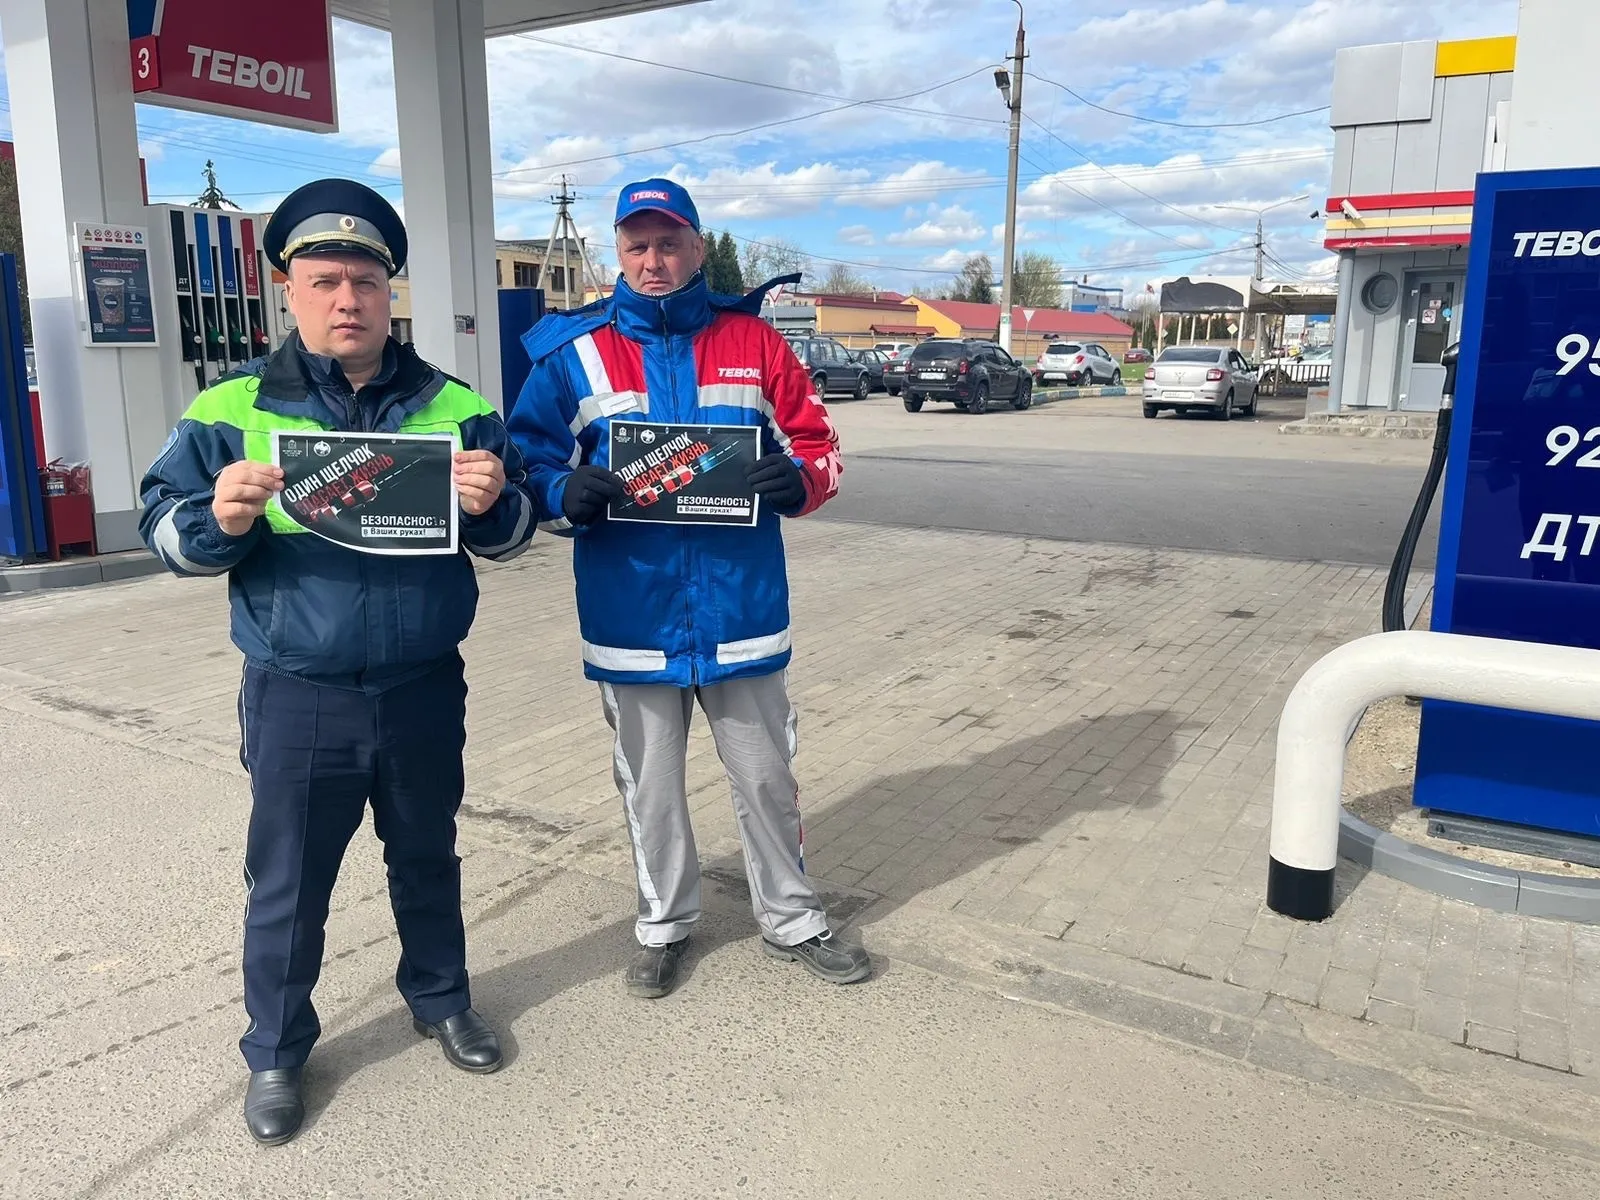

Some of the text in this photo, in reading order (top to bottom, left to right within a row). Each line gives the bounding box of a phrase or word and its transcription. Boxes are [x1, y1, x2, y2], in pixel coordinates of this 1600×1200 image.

[138, 47, 150, 79] 3
[187, 44, 312, 100] TEBOIL
[633, 191, 666, 201] TEBOIL
[178, 277, 189, 286] ДТ
[202, 278, 211, 287] 92
[225, 280, 234, 288] 95
[717, 367, 762, 380] TEBOIL
[644, 431, 694, 468] ЩЕЛЧОК
[284, 442, 376, 503] ОДИН ЩЕЛЧОК
[347, 453, 394, 485] ЖИЗНЬ
[623, 440, 710, 496] СПАСАЕТ ЖИЗНЬ
[677, 495, 751, 507] БЕЗОПАСНОСТЬ
[361, 515, 446, 526] БЕЗОПАСНОСЬ
[399, 528, 427, 537] руках!
[1520, 513, 1600, 562] ДТ
